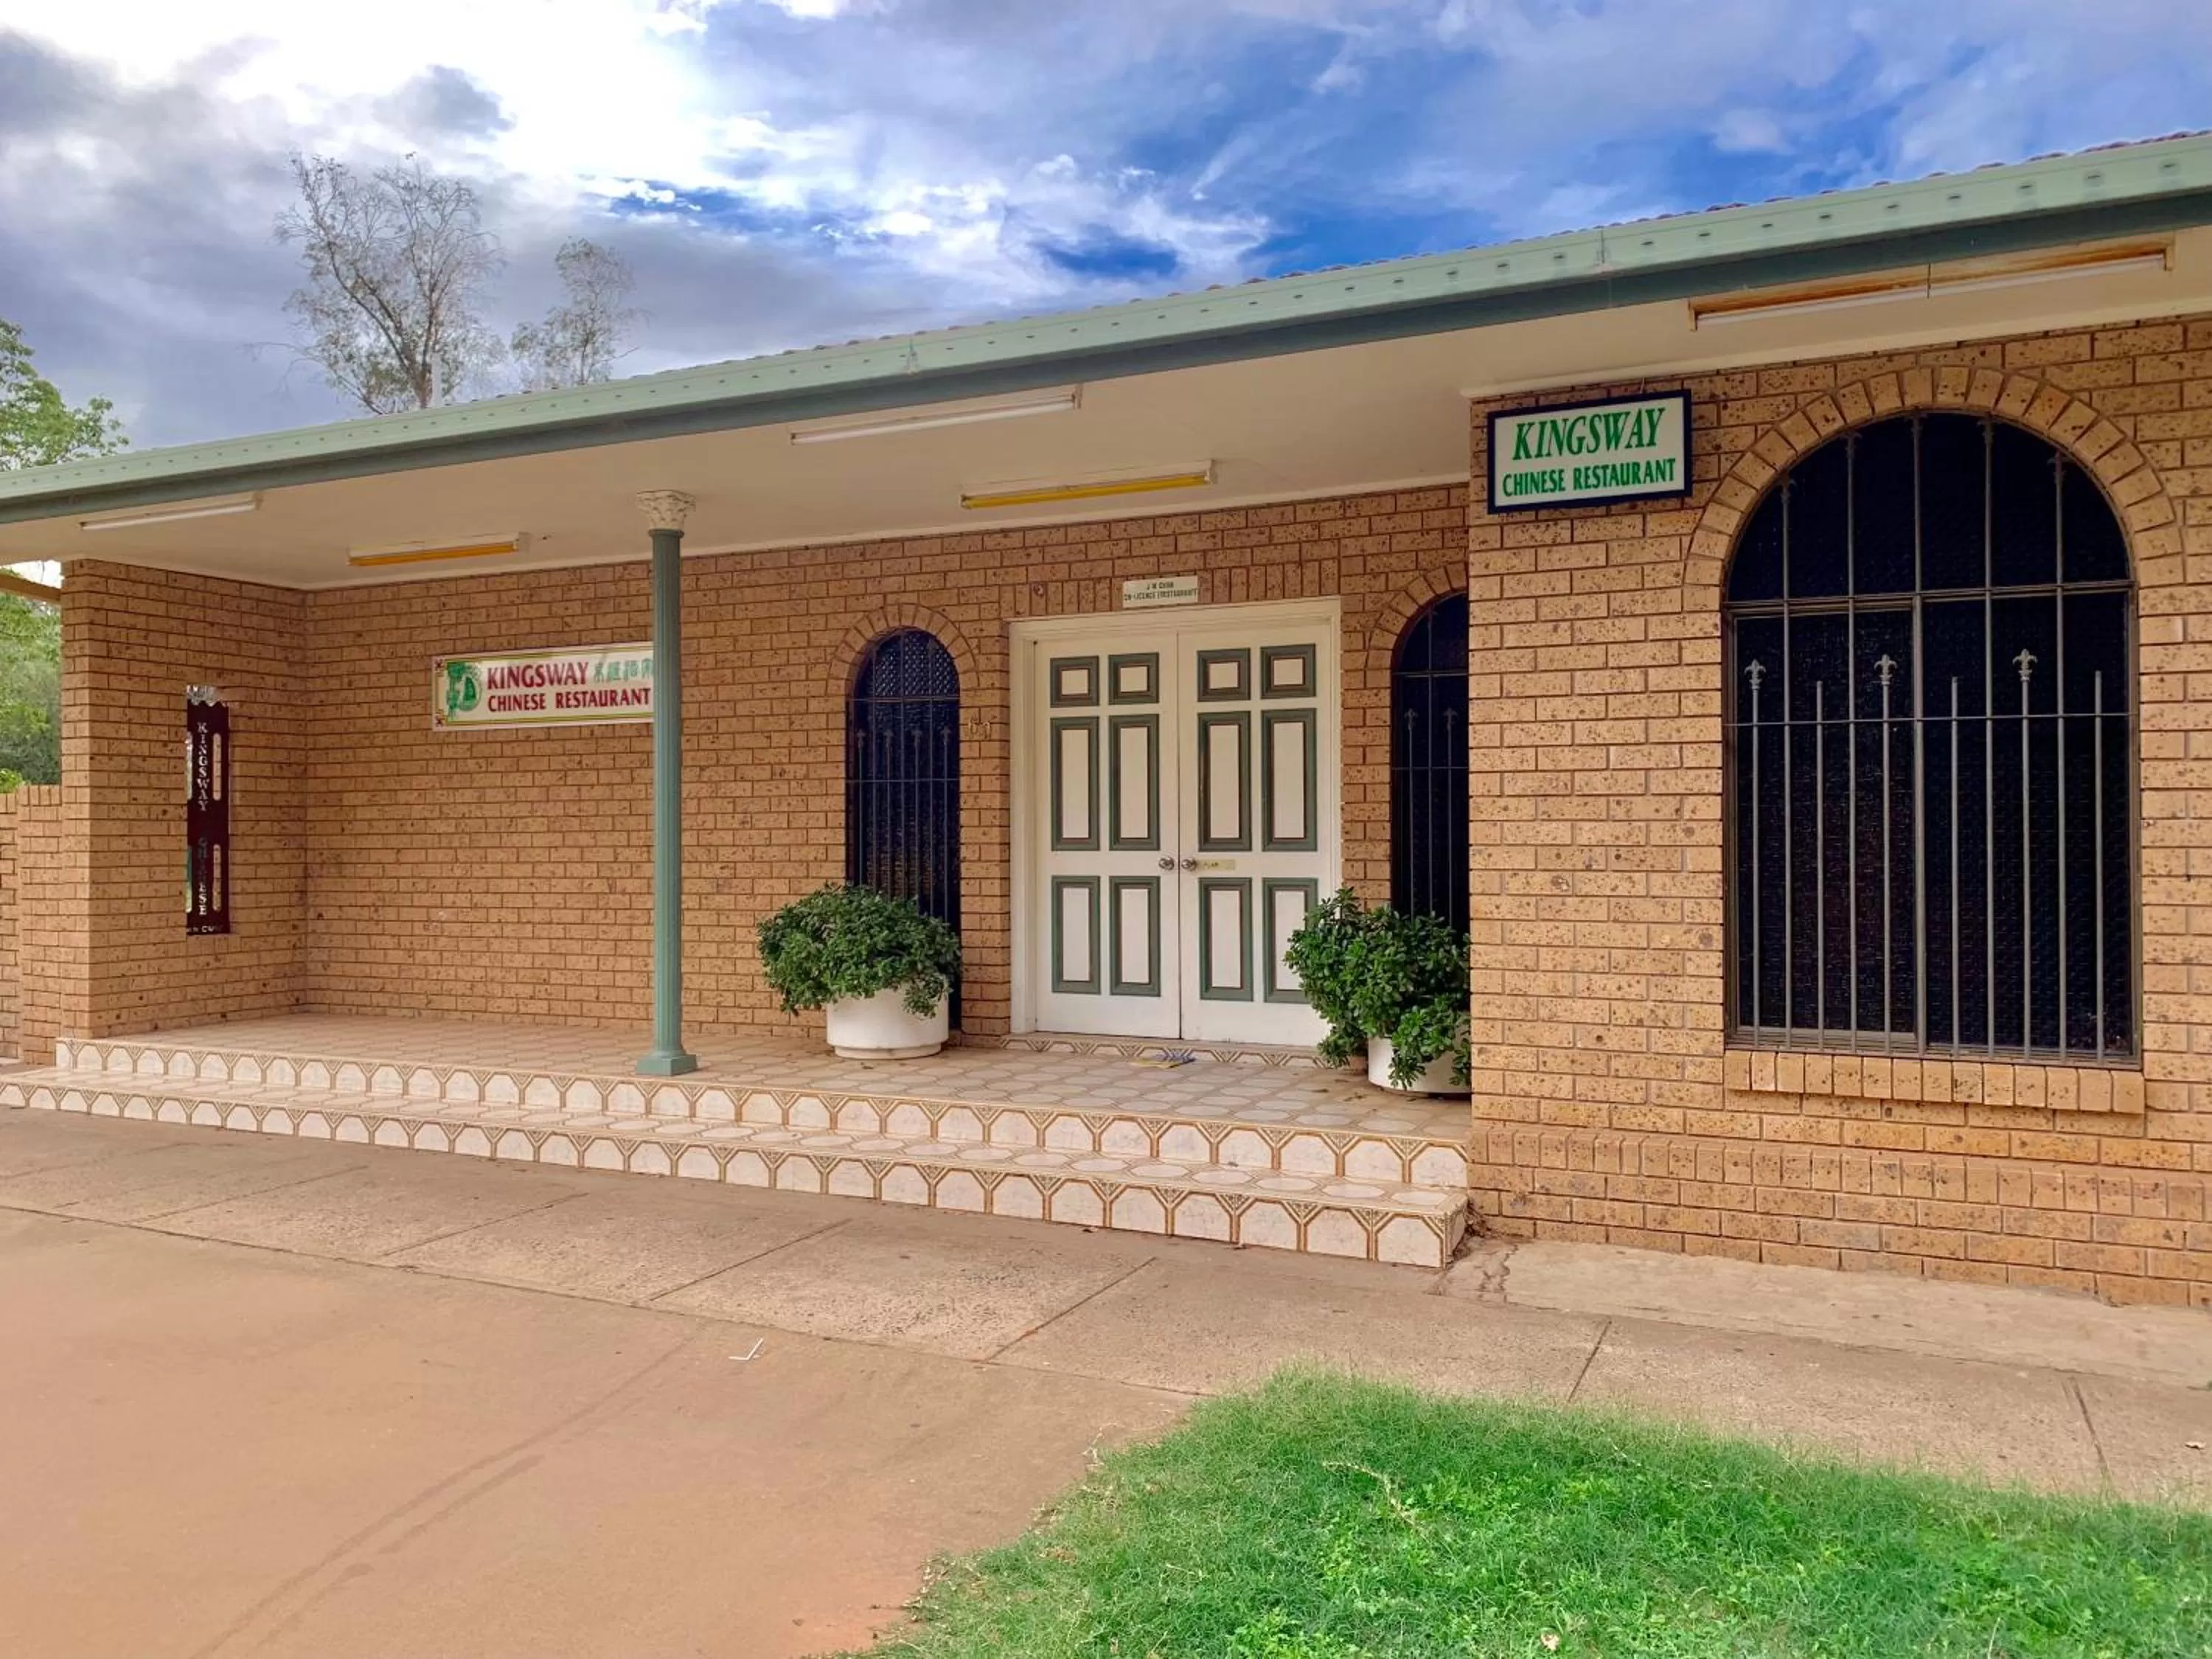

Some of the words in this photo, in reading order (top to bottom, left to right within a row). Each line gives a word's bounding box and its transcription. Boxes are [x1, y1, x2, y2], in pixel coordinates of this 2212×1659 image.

[1512, 407, 1666, 461] KINGSWAY
[1502, 468, 1565, 497] CHINESE
[1573, 458, 1676, 491] RESTAURANT
[487, 661, 590, 690] KINGSWAY
[488, 692, 546, 712] CHINESE
[555, 687, 651, 709] RESTAURANT
[197, 722, 209, 811] KINGSWAY
